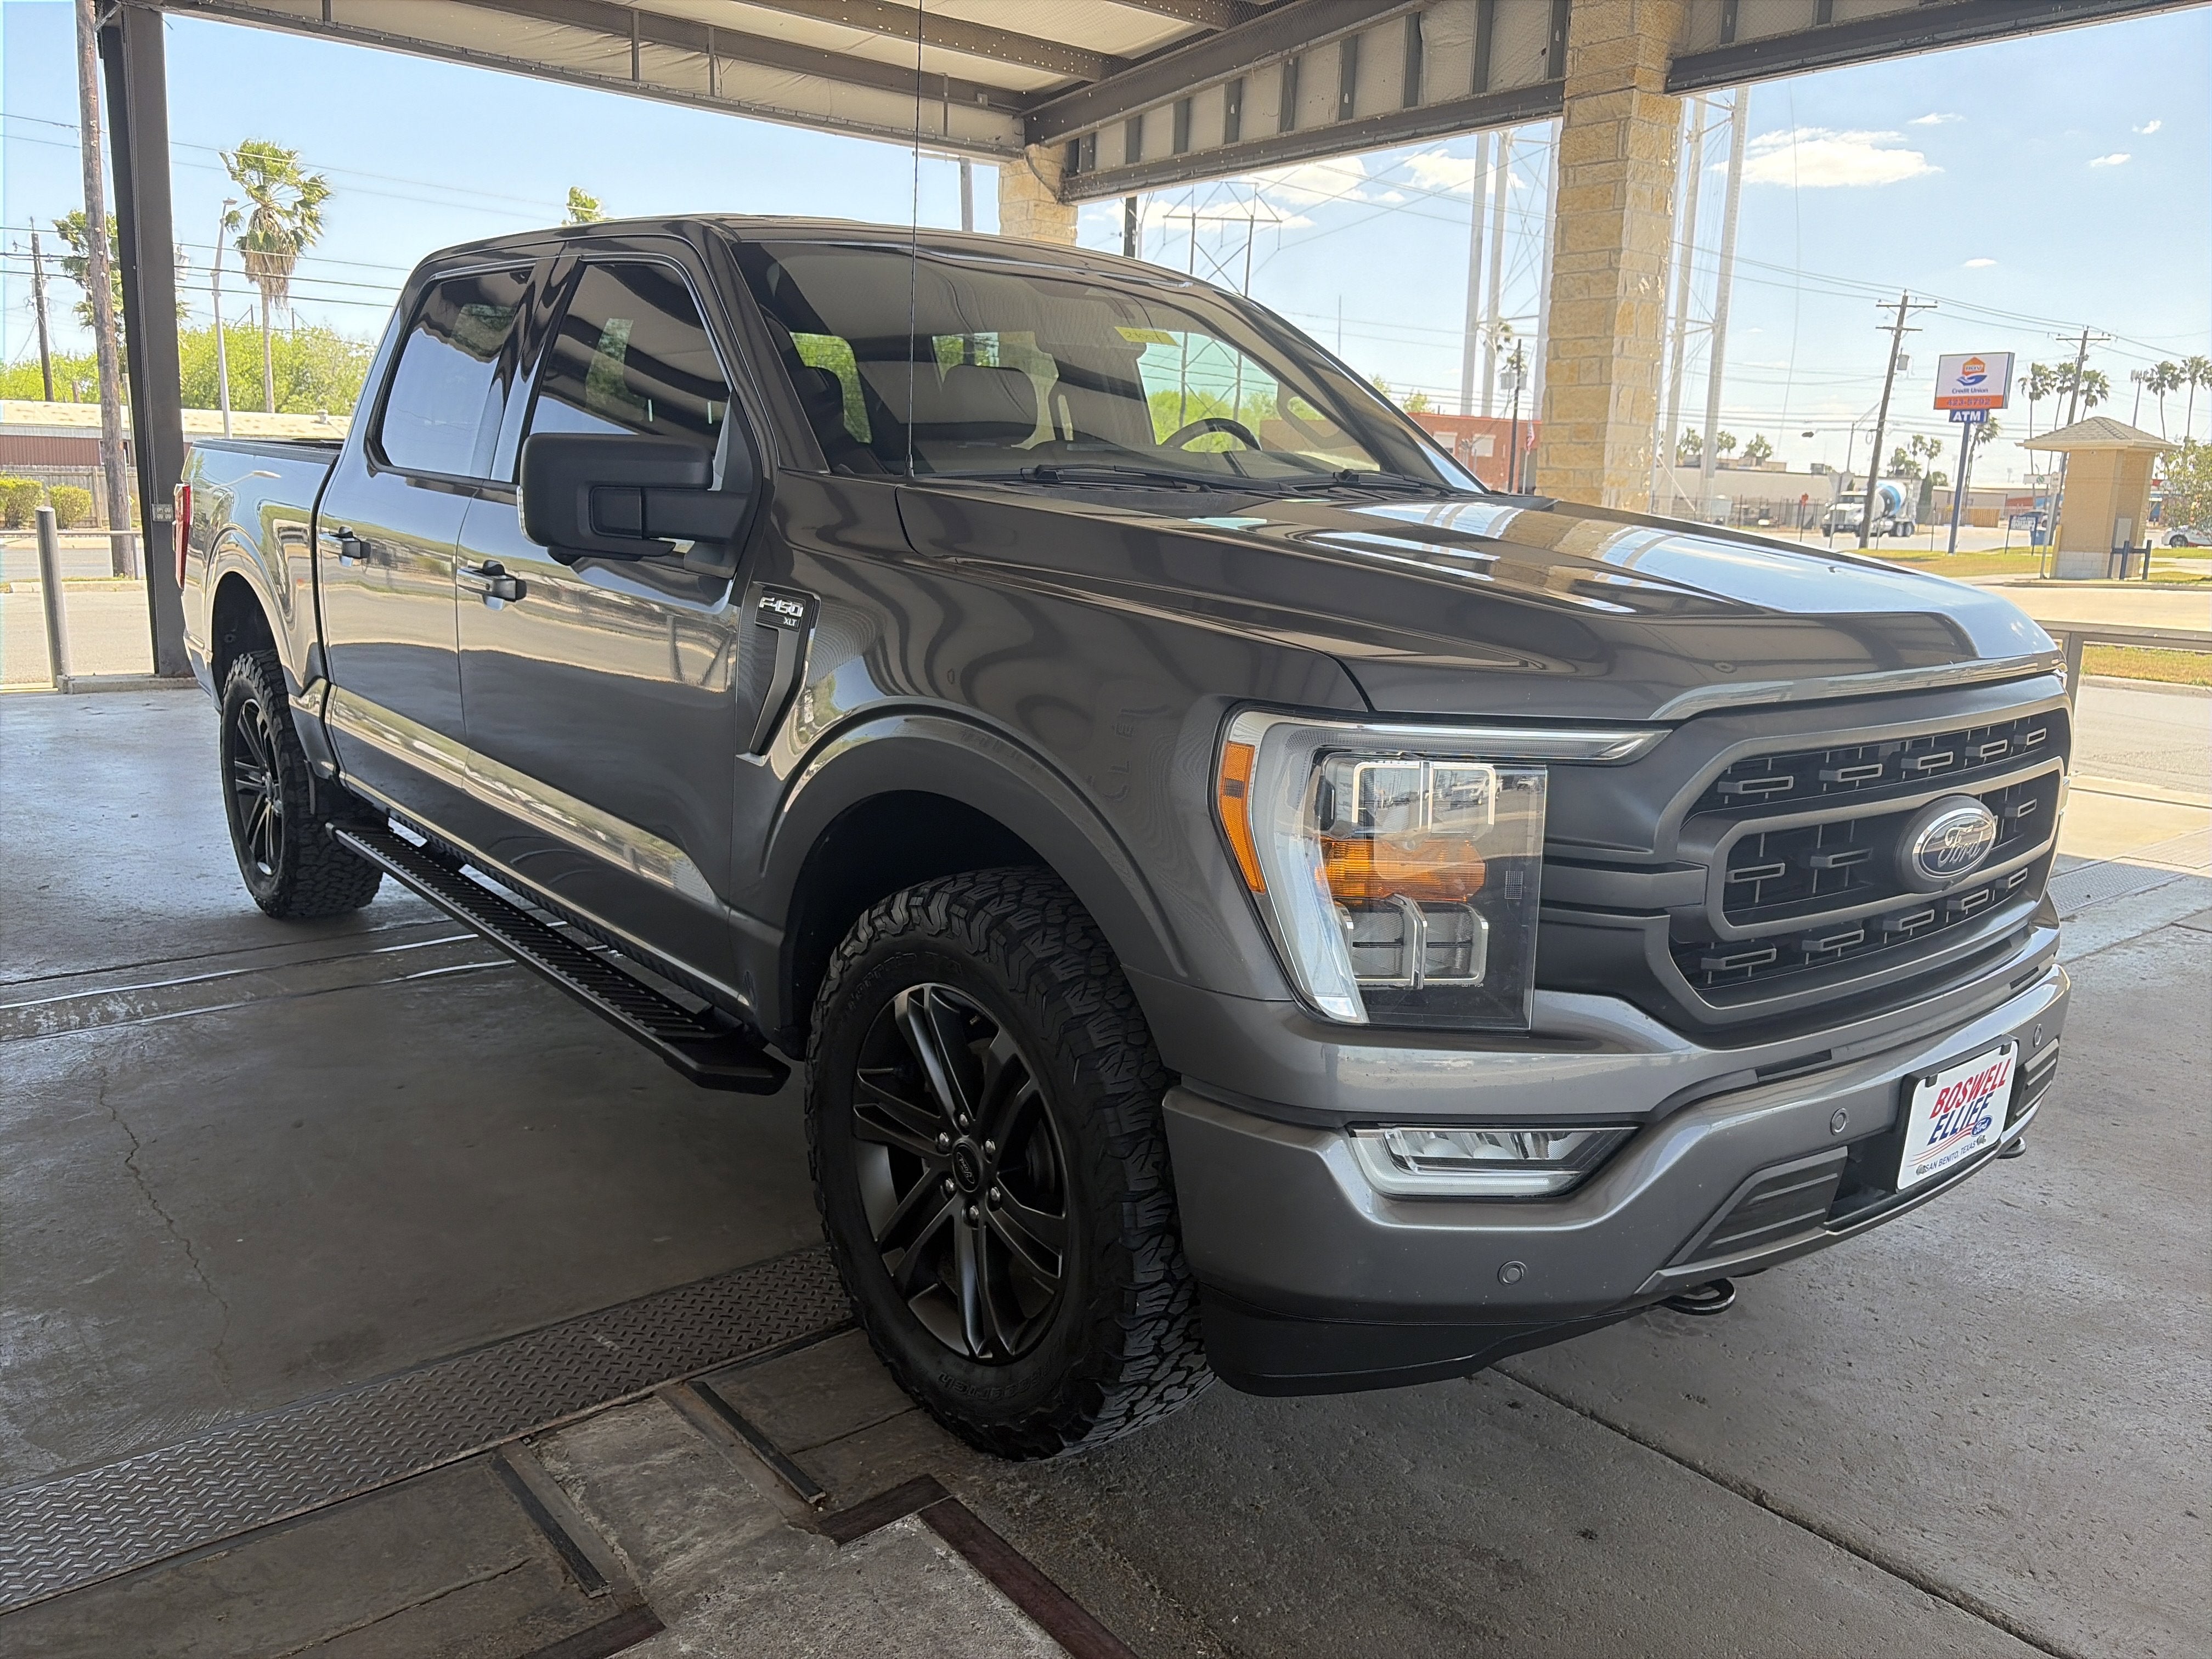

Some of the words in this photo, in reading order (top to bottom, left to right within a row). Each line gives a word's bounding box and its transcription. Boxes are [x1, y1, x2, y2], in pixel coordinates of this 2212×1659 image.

[1953, 411, 1981, 422] ATM
[783, 617, 797, 627] XLT
[1937, 825, 1984, 868] Ford
[1929, 1058, 2011, 1120] BOSWELL
[1927, 1091, 1994, 1146] ELLIFF
[959, 1157, 972, 1177] Ford
[1925, 1160, 1937, 1173] SAN
[1938, 1150, 1959, 1169] BENITO,
[1960, 1142, 1977, 1155] TEXAS
